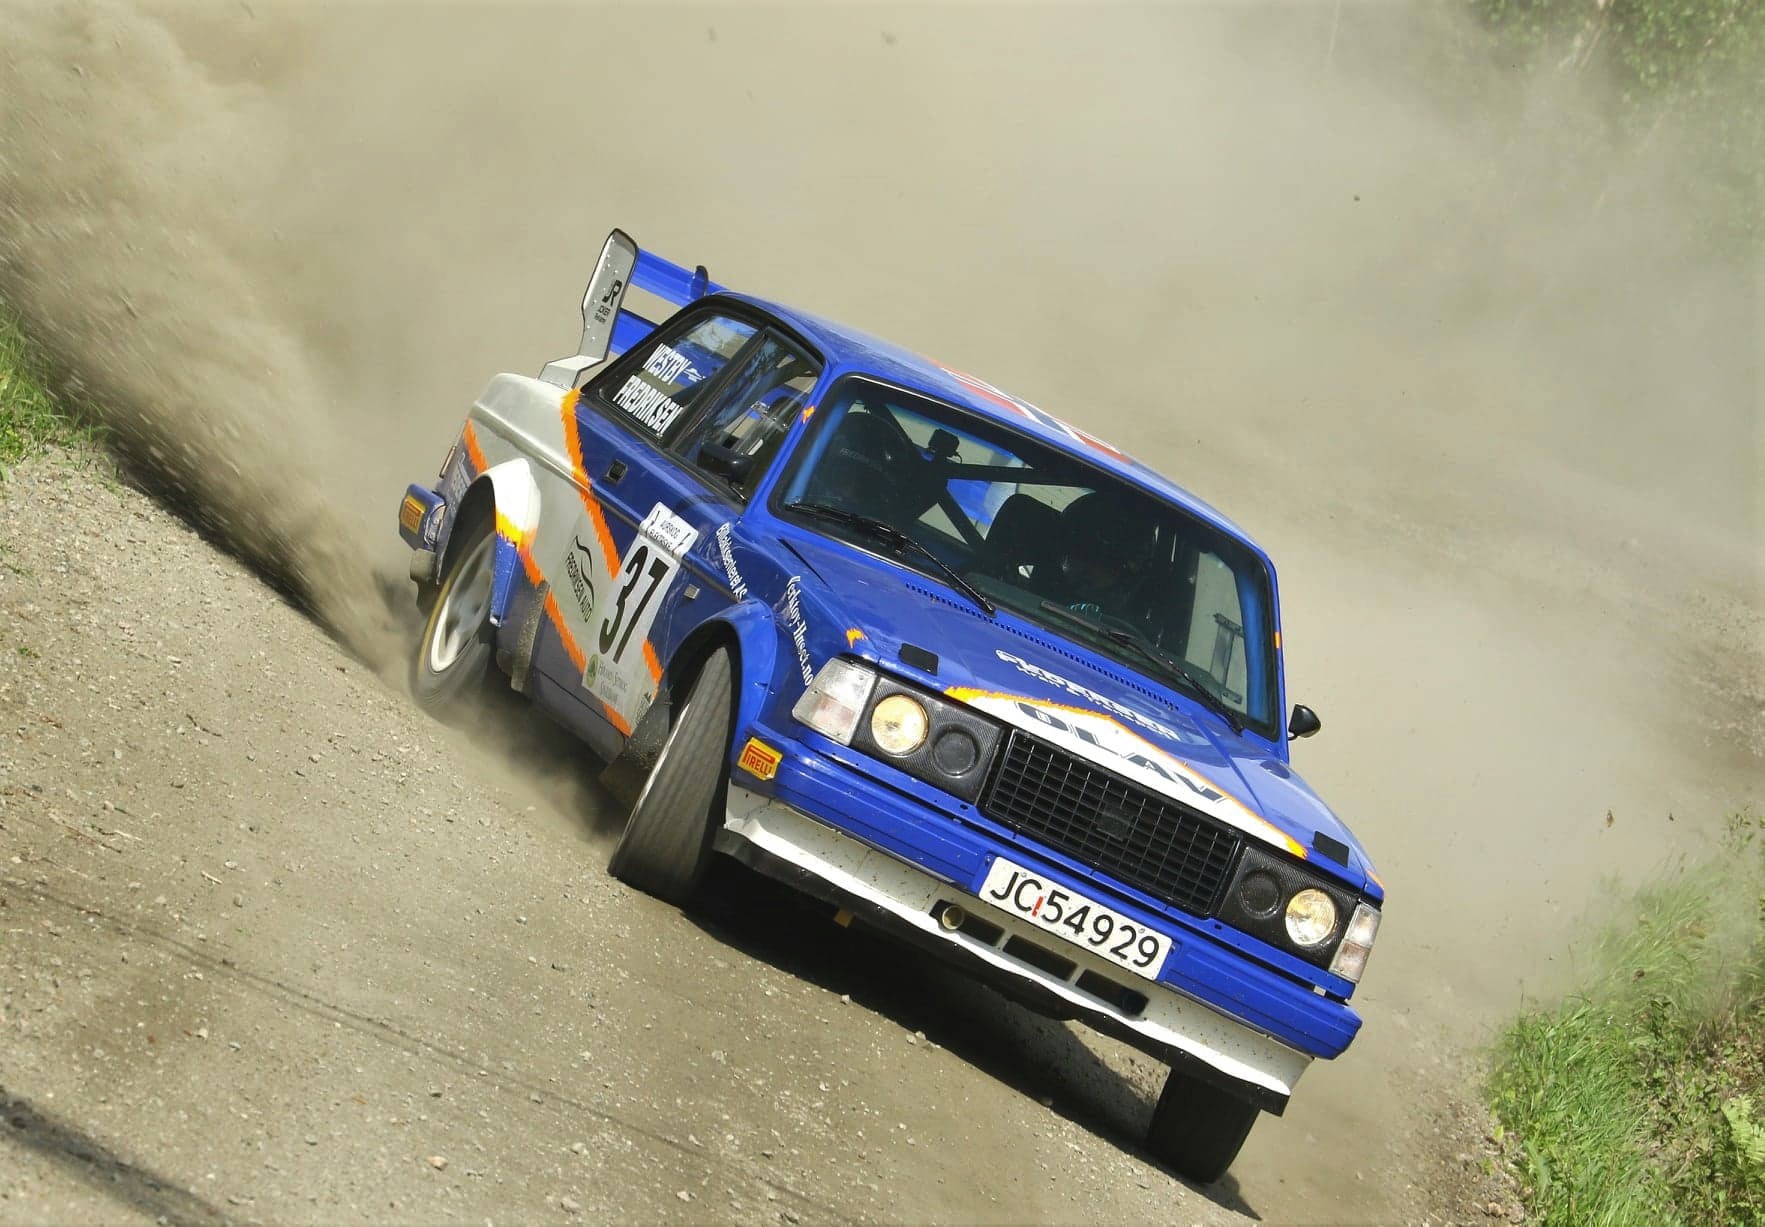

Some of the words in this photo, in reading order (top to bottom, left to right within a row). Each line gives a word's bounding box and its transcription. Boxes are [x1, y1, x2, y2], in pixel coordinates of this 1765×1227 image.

[642, 343, 692, 385] WESTBY
[612, 374, 684, 435] FREDRIKSEN
[599, 545, 669, 665] 37
[743, 744, 776, 776] PIRELLI
[1041, 889, 1160, 968] 54929
